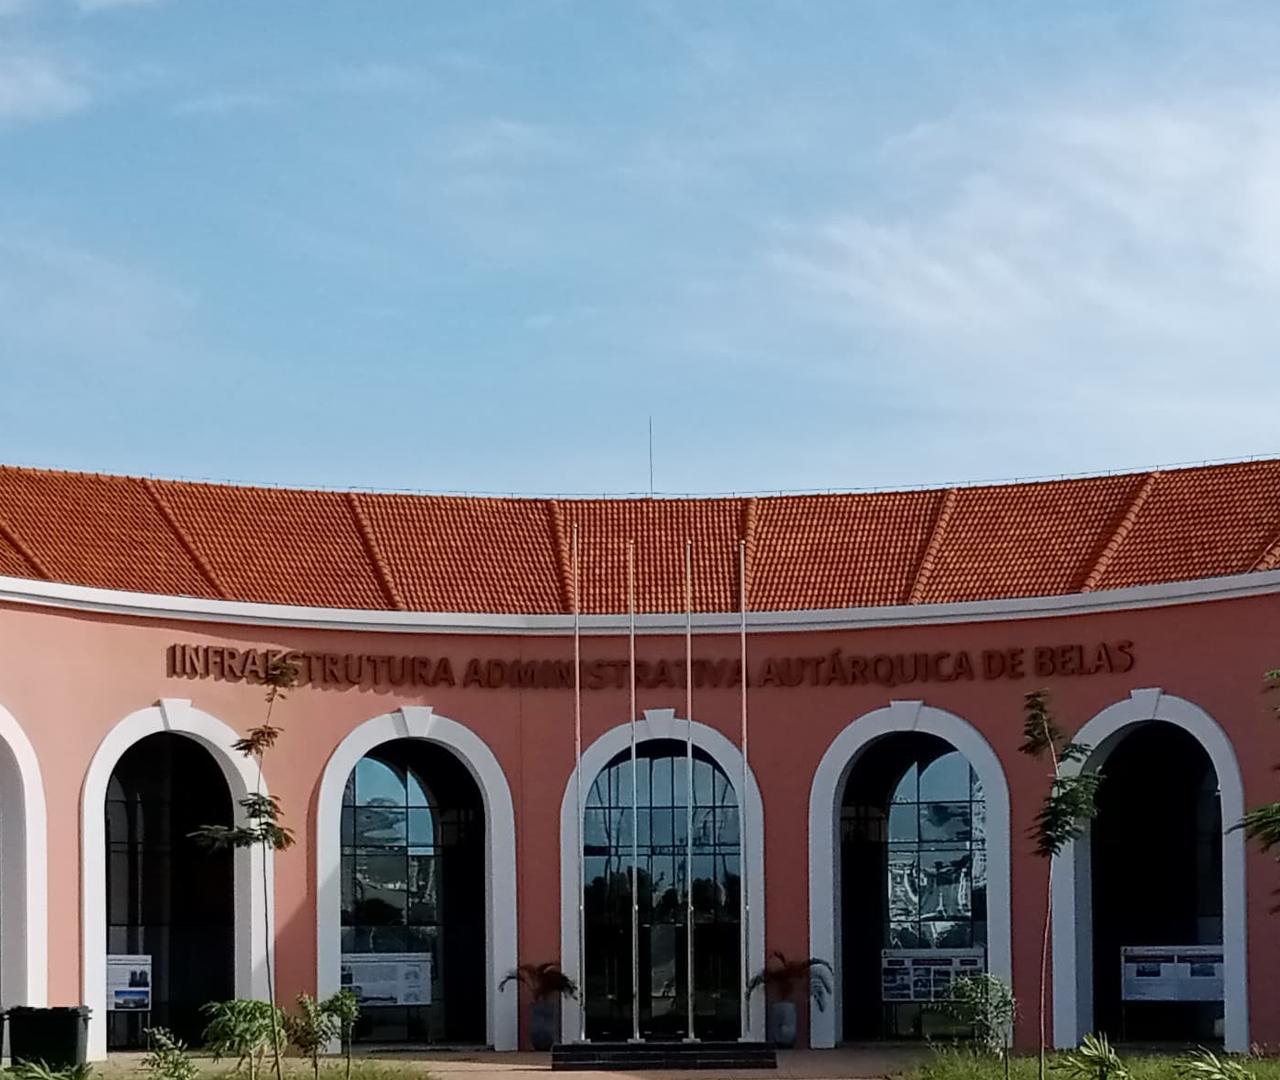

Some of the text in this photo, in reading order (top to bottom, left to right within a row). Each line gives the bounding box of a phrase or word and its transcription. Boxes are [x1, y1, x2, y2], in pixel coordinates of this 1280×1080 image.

[760, 648, 974, 688] AUTÁRQUICA
[983, 648, 1024, 680] DE
[1035, 640, 1134, 677] BELAS
